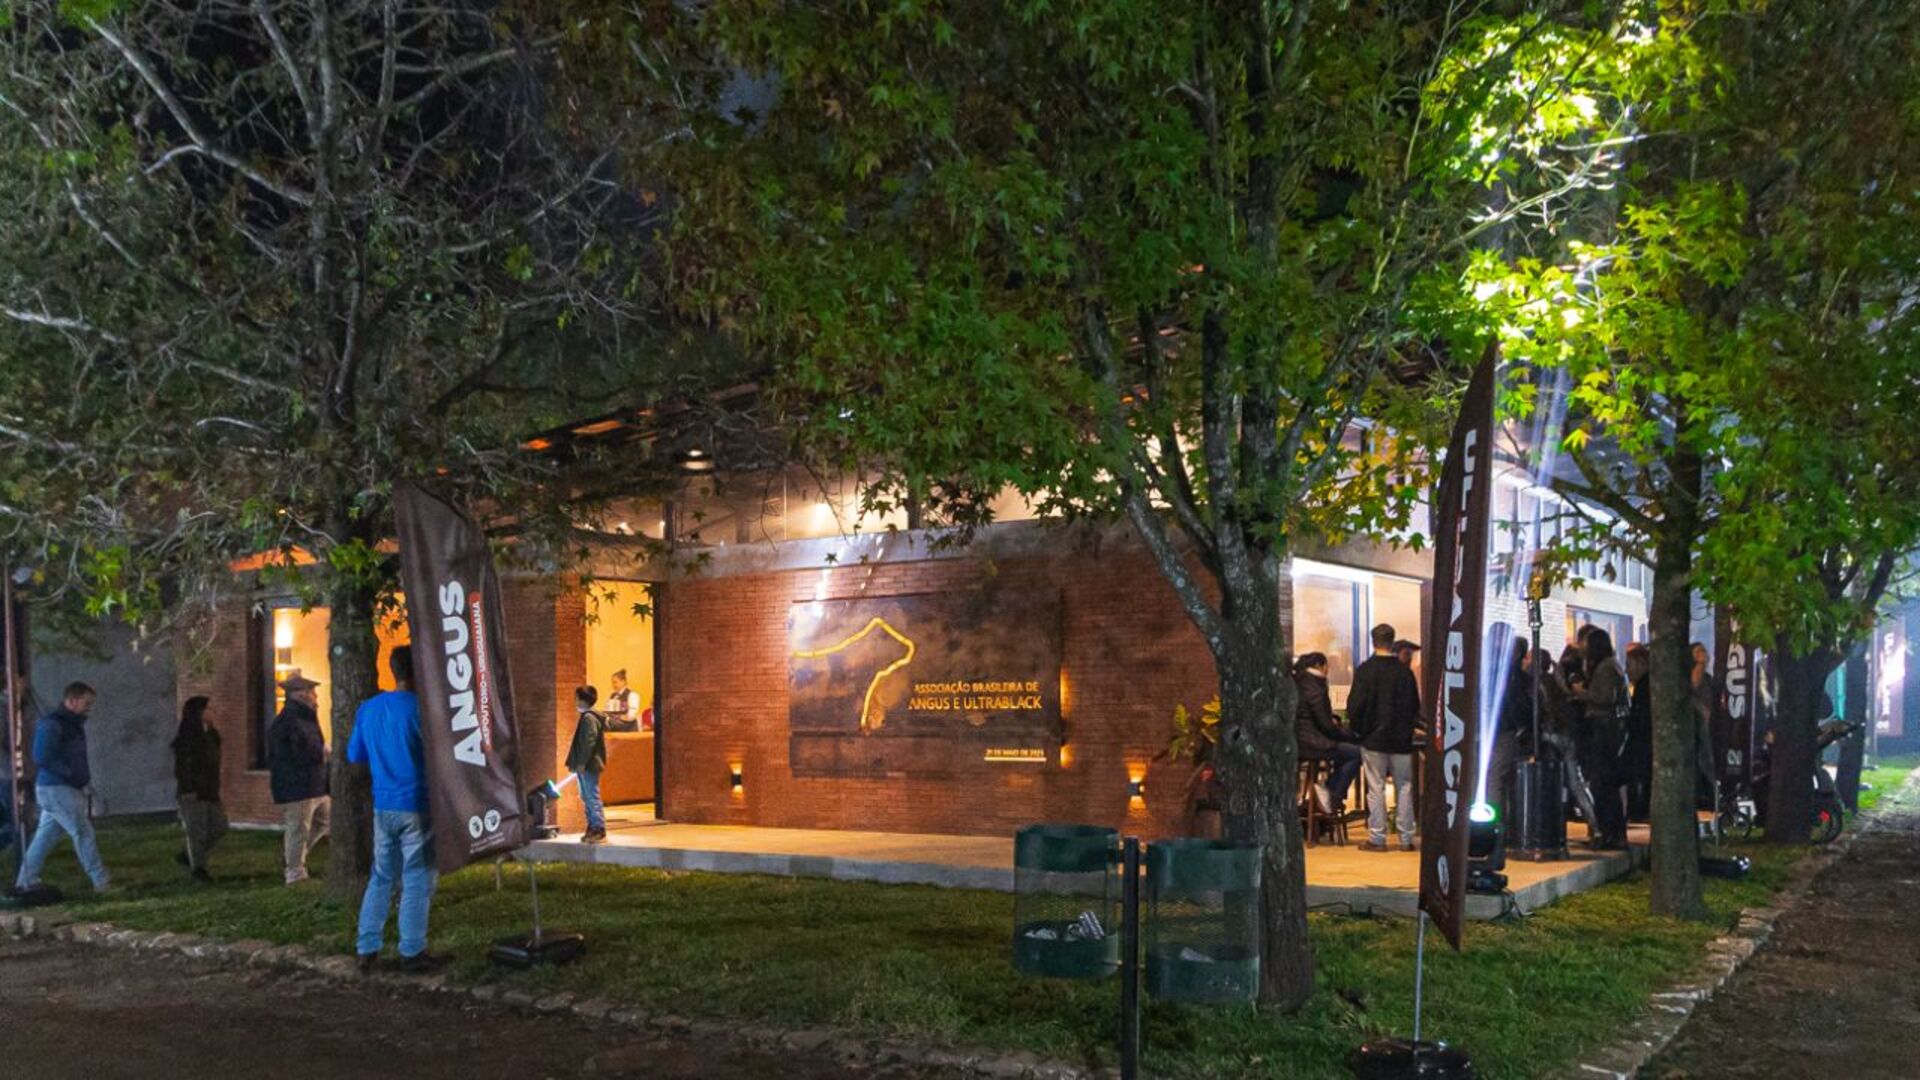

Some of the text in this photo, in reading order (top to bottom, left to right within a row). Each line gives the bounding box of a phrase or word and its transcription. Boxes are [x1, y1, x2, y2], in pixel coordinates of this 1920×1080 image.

[439, 581, 486, 767] ANGUS
[914, 680, 1039, 694] ASSOCIAÇÃO BRASILEIRA DE
[908, 695, 1042, 710] ANGUS E ULTRABLACK
